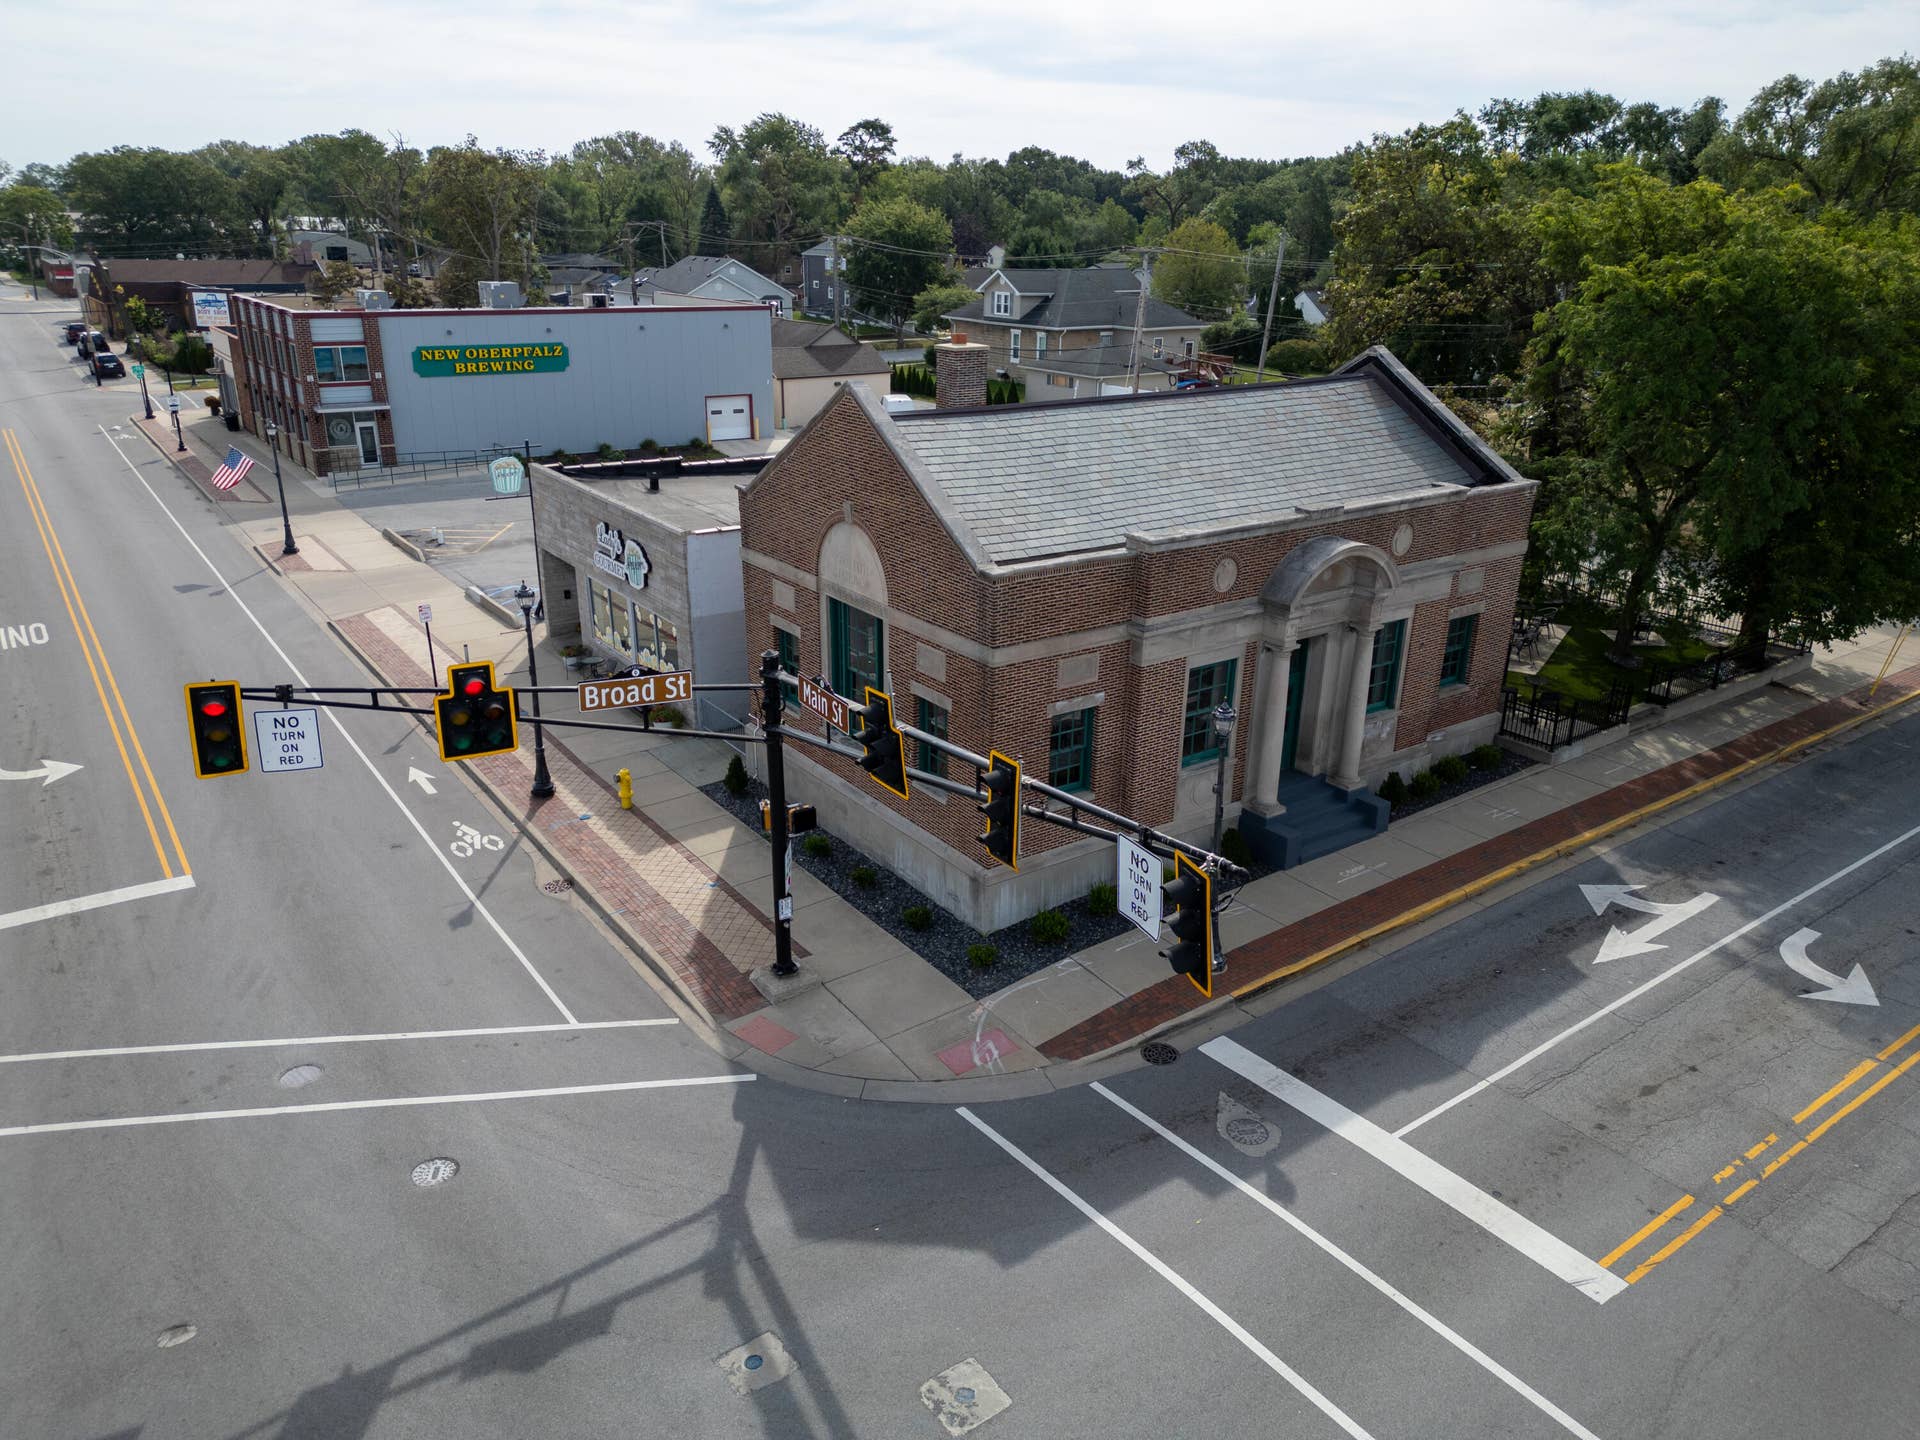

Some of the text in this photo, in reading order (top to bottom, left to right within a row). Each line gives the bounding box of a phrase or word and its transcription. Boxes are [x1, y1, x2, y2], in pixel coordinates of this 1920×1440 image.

[421, 346, 563, 360] NEW OBERPFALZ
[455, 360, 535, 373] BREWING
[584, 676, 686, 708] Broad St
[803, 681, 843, 728] Main St
[273, 716, 299, 729] NO
[272, 730, 305, 741] TURN
[281, 744, 299, 753] ON
[279, 755, 304, 765] RED
[1130, 850, 1149, 874] NO
[1129, 868, 1152, 893] TURN
[1134, 888, 1146, 905] ON
[1131, 902, 1148, 922] RED
